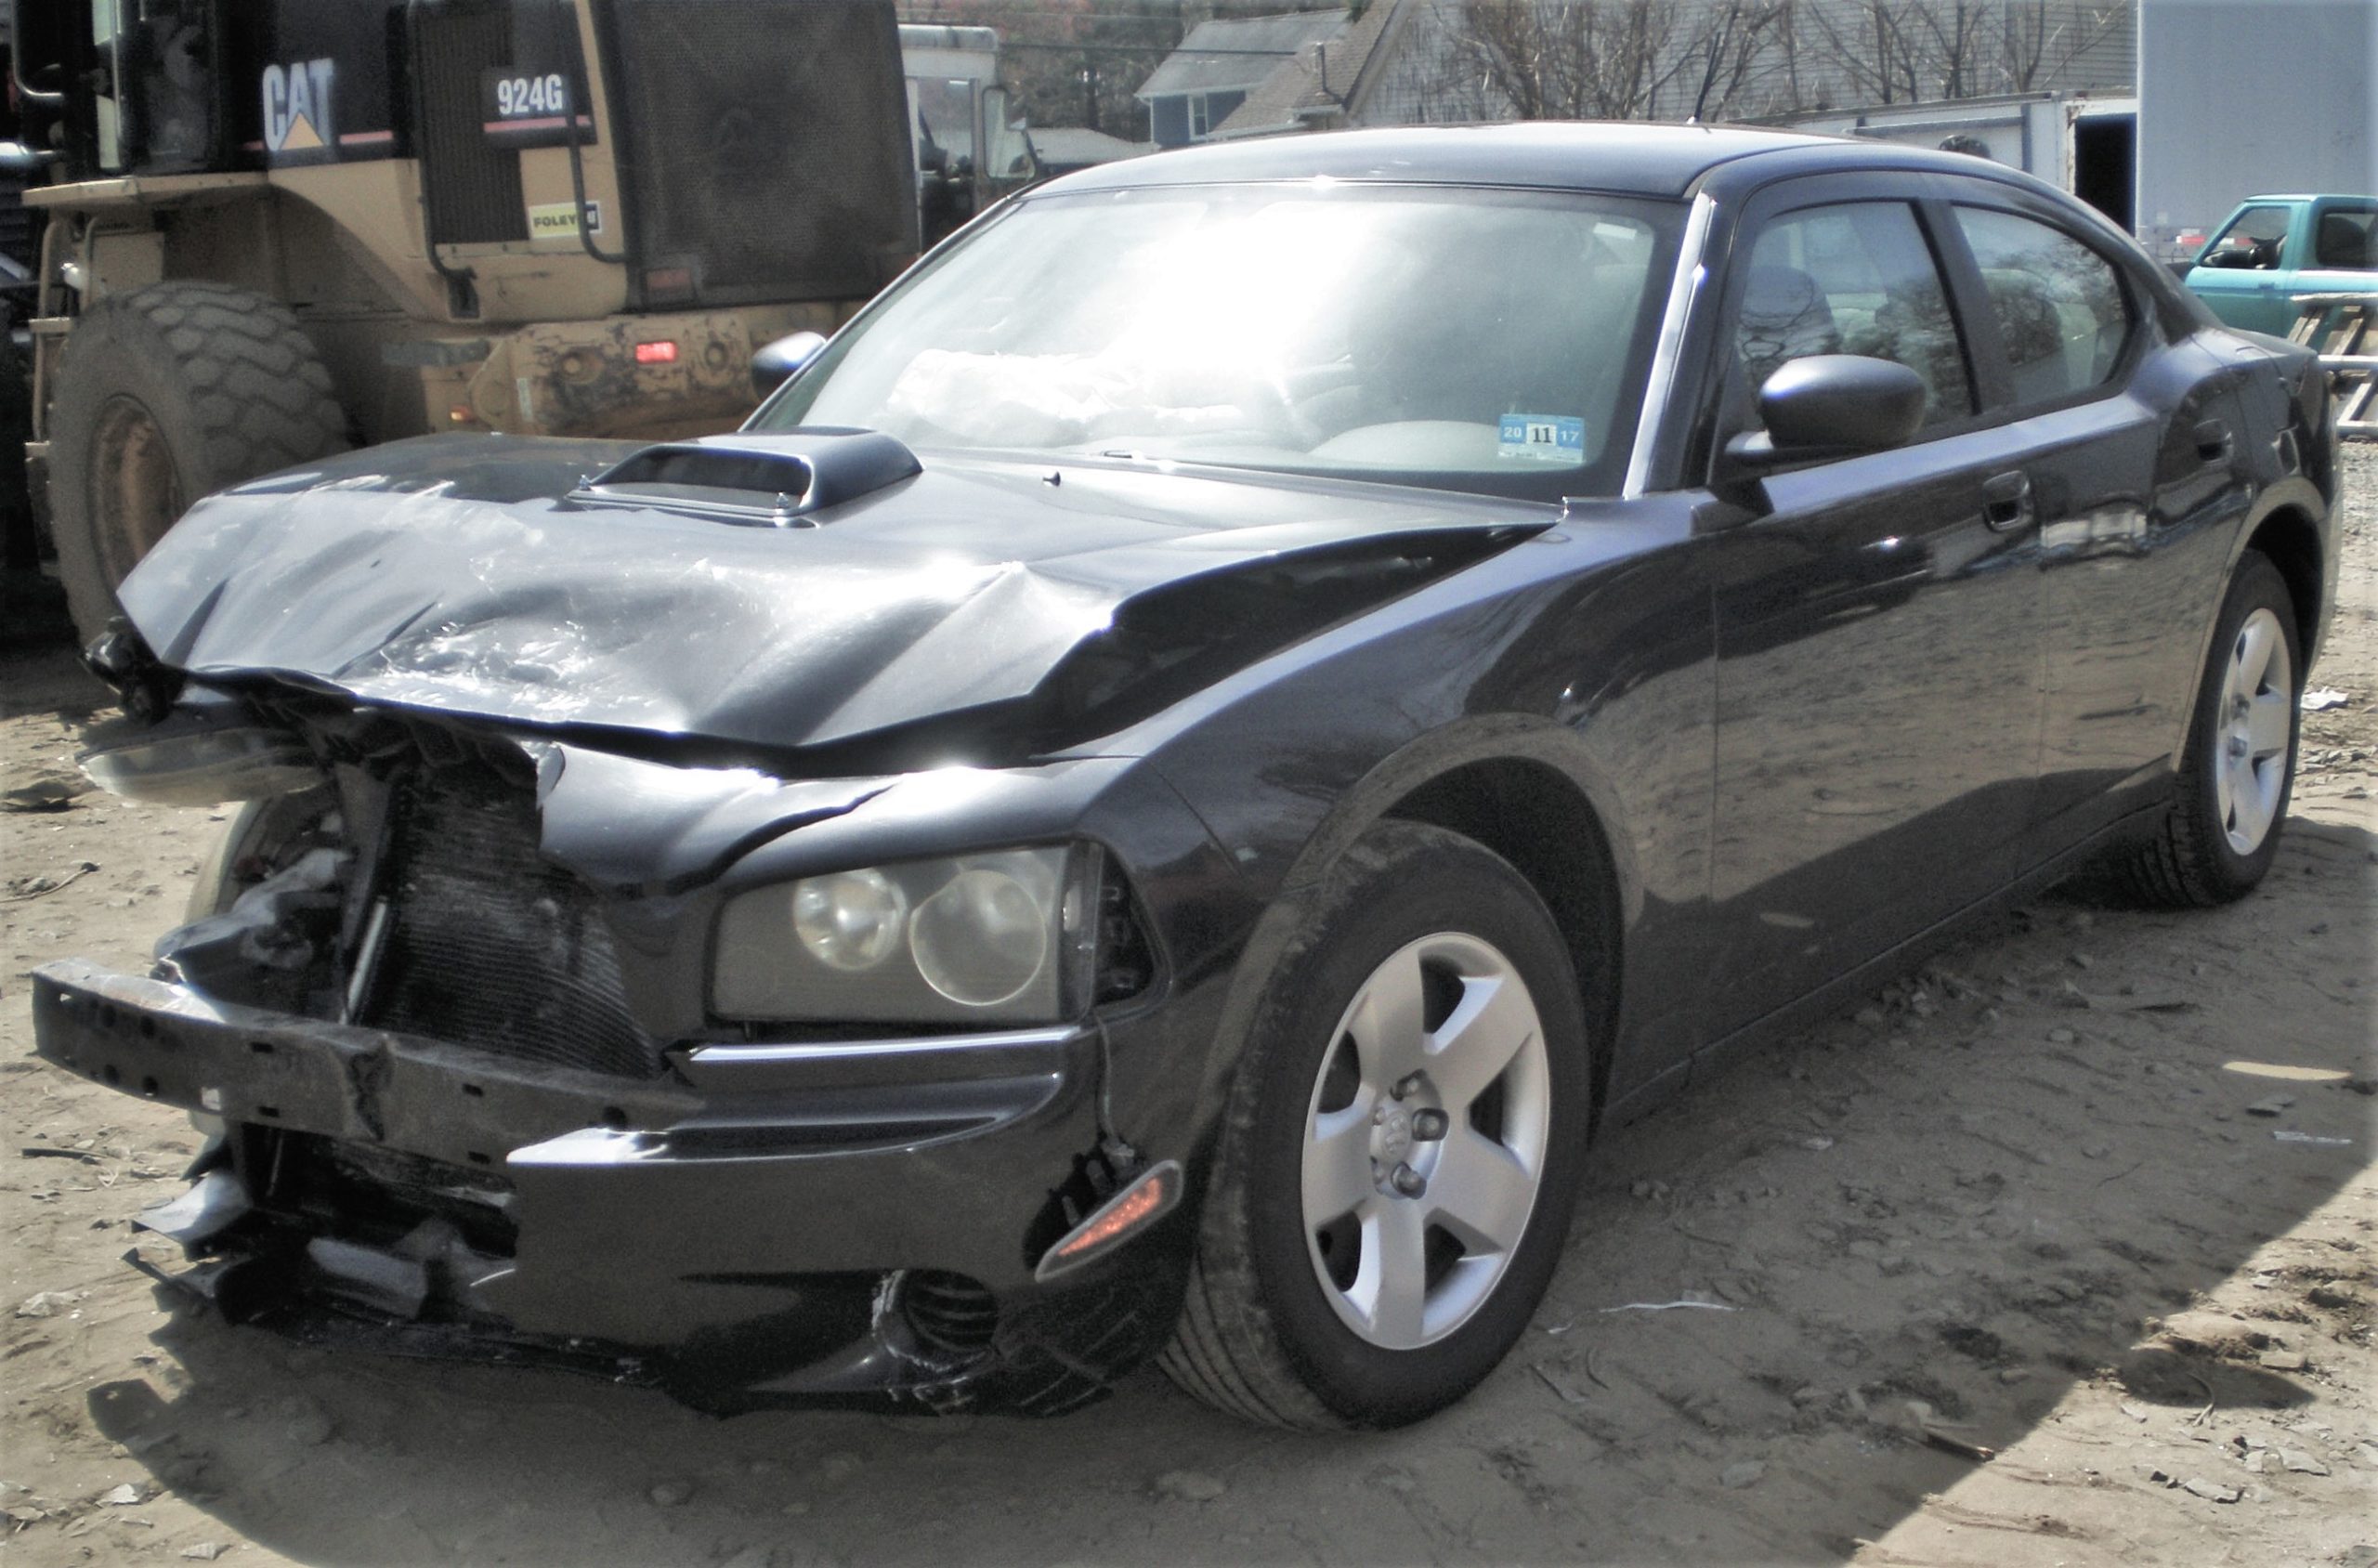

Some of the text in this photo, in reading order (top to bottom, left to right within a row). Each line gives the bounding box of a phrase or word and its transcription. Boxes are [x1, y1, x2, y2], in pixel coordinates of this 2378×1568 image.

[263, 58, 333, 151] CAT
[498, 74, 563, 115] 924G
[533, 214, 578, 228] FOLEY
[1504, 426, 1579, 443] 20 11 17
